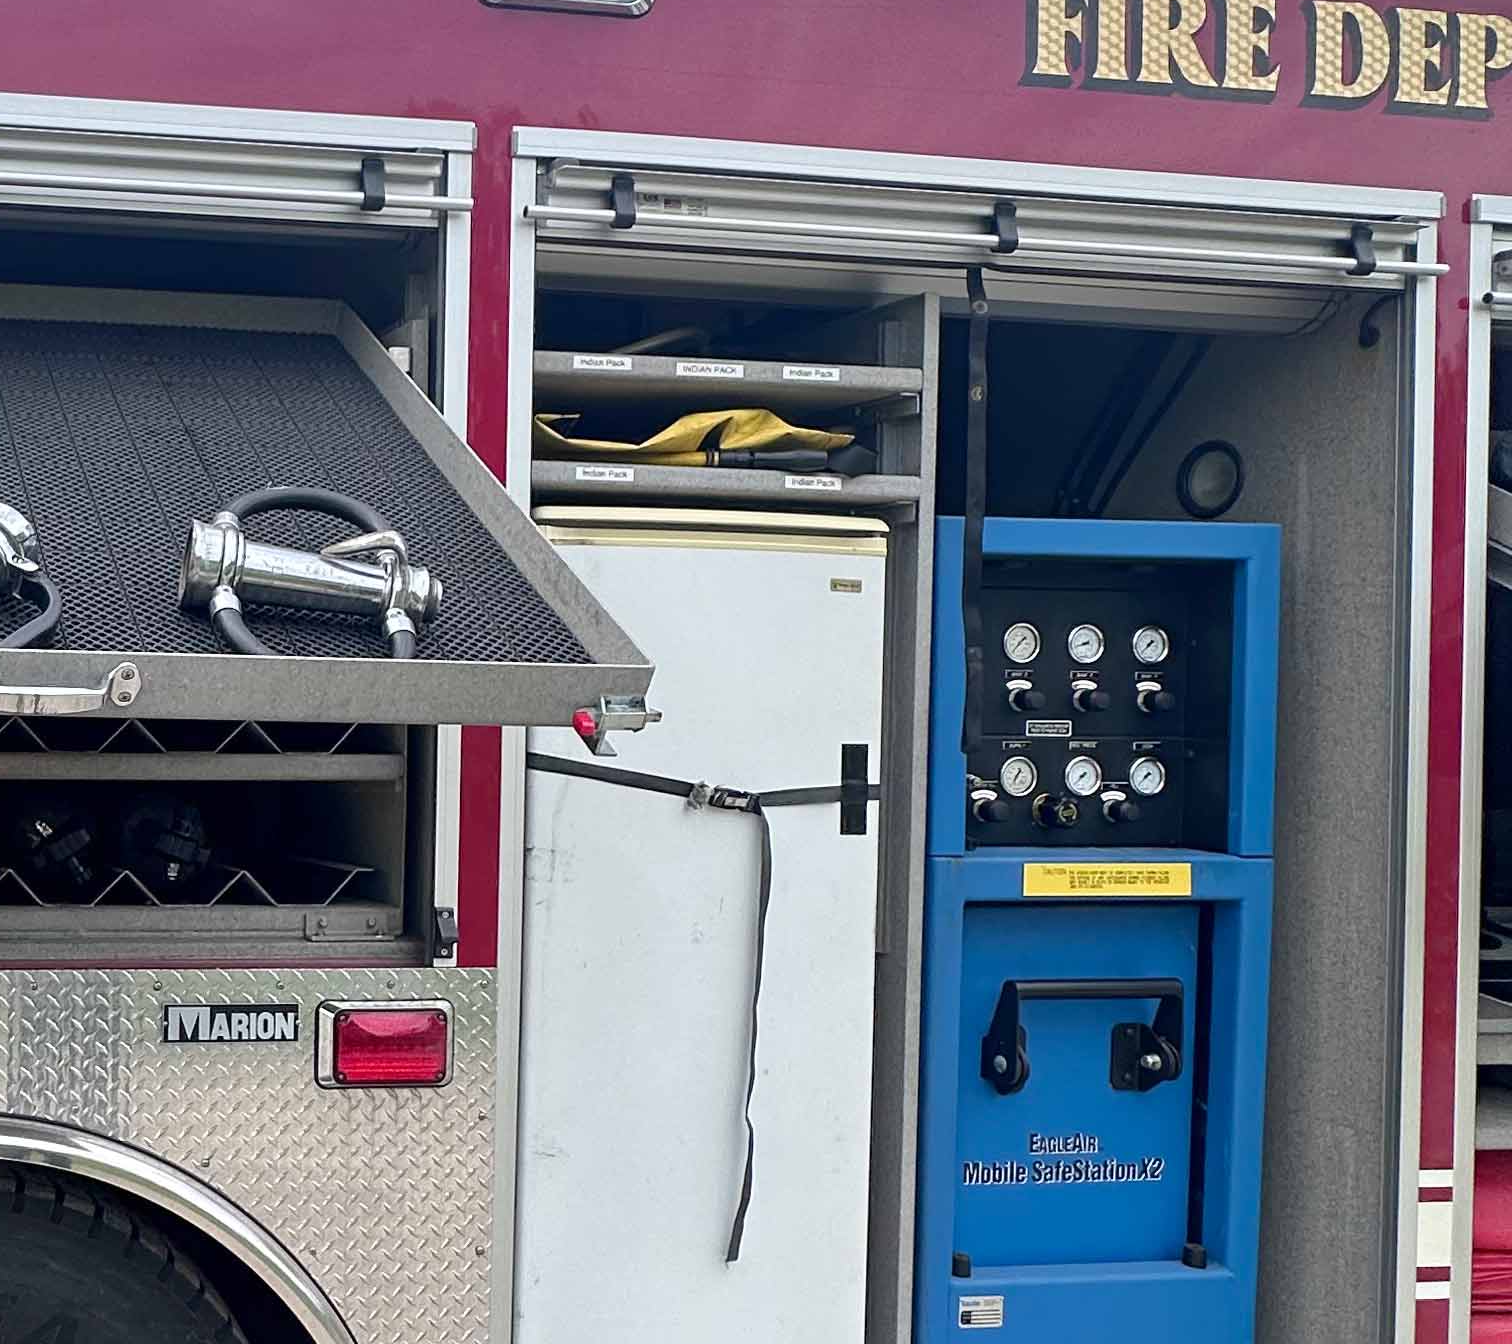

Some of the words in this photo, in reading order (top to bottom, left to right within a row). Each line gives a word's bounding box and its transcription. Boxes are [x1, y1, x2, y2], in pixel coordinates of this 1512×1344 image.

[1301, 0, 1512, 120] DEP
[605, 358, 626, 367] Pack
[682, 365, 712, 374] INDIAN
[714, 366, 737, 375] PACK
[789, 368, 813, 377] Indian
[815, 369, 834, 378] Pack
[608, 469, 628, 478] Pack
[792, 477, 815, 487] Indian
[816, 478, 836, 488] Pack
[167, 1005, 297, 1041] MARION
[963, 1160, 1028, 1186] Mobile
